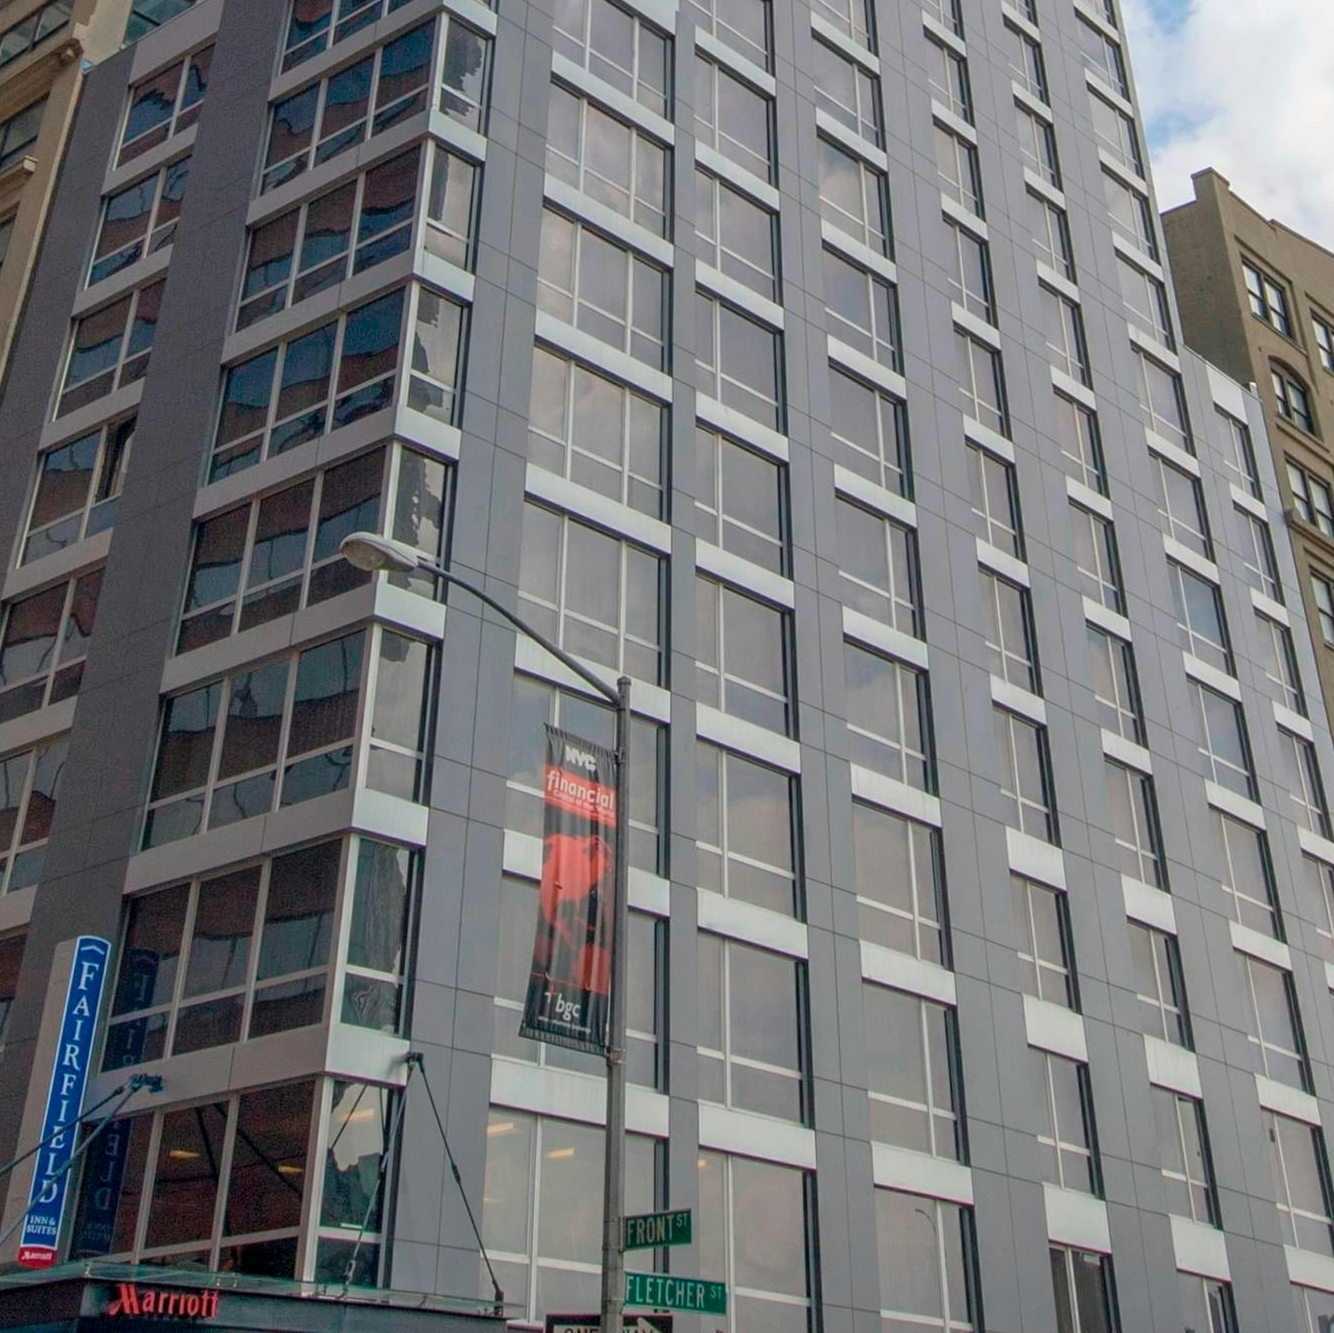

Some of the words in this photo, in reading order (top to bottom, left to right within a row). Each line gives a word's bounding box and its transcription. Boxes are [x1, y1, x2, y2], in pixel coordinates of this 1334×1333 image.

[565, 745, 596, 772] NYC
[547, 769, 614, 811] financial
[555, 993, 581, 1021] bgc
[39, 961, 99, 1203] FAIRFIELD
[27, 1224, 57, 1235] SUITES
[29, 1215, 48, 1224] INN
[627, 1215, 674, 1245] FRONT
[676, 1213, 688, 1227] ST
[108, 1282, 219, 1317] Marriott
[625, 1275, 705, 1308] FLETCHER
[710, 1285, 722, 1298] ST
